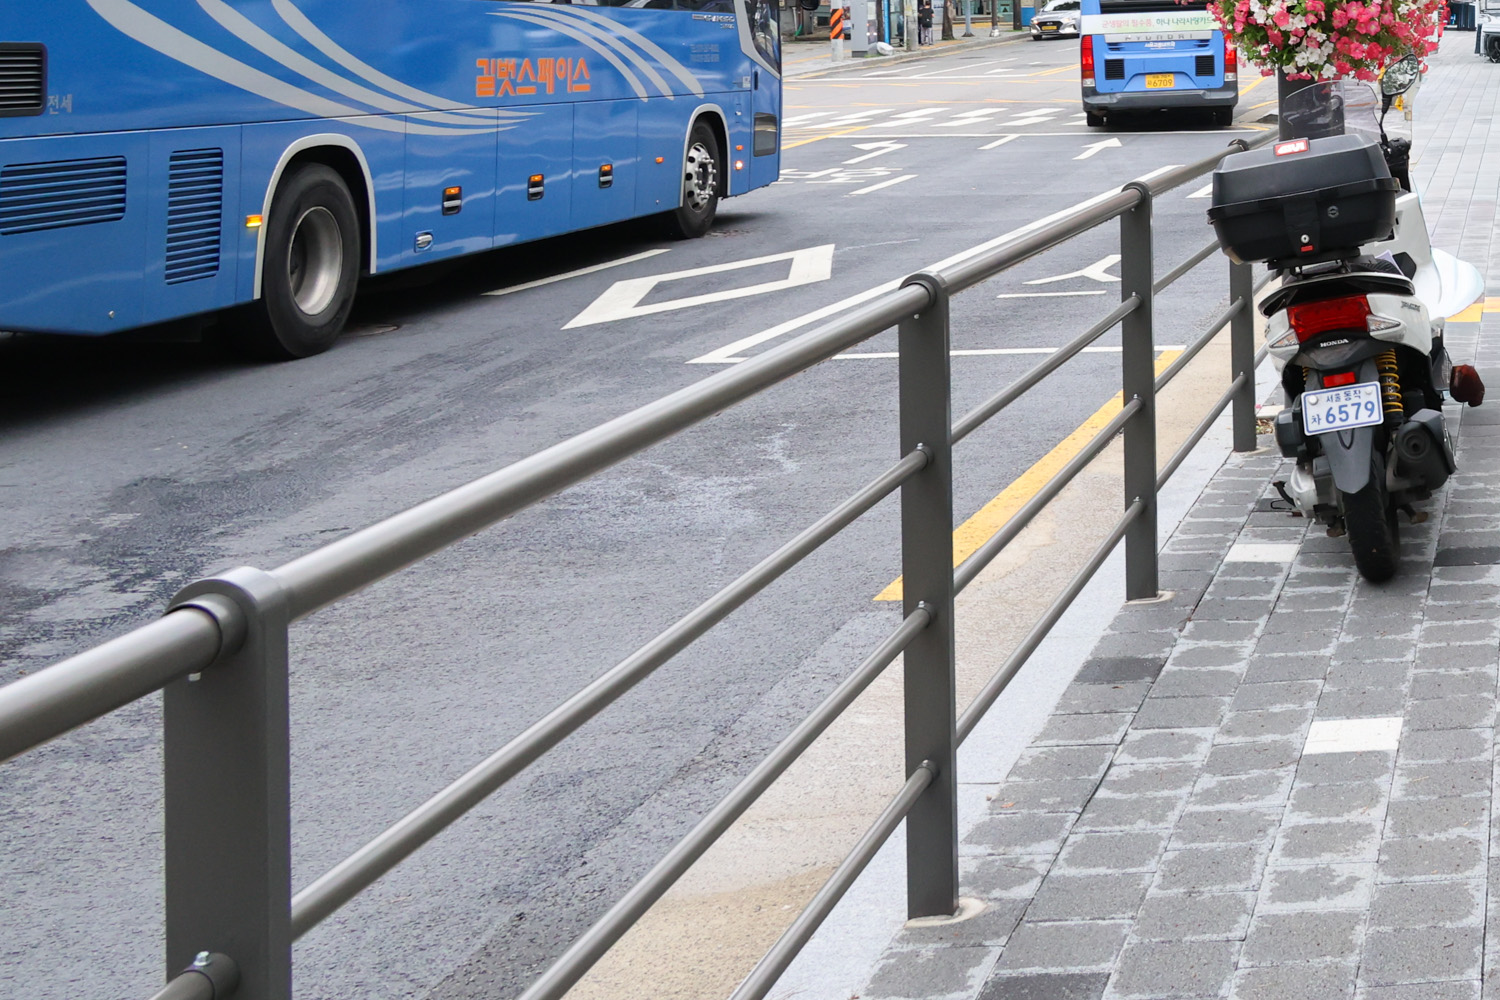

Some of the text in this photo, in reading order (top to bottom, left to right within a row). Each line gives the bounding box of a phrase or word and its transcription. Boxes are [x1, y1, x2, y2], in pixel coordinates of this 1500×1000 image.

[1156, 17, 1171, 26] 하나
[476, 57, 591, 98] 길벗스페이스
[1153, 78, 1173, 88] 6709
[47, 93, 73, 115] 전세
[1320, 339, 1349, 349] HONDA
[1326, 389, 1362, 403] 서울 동작
[1311, 400, 1376, 426] 차 6579
